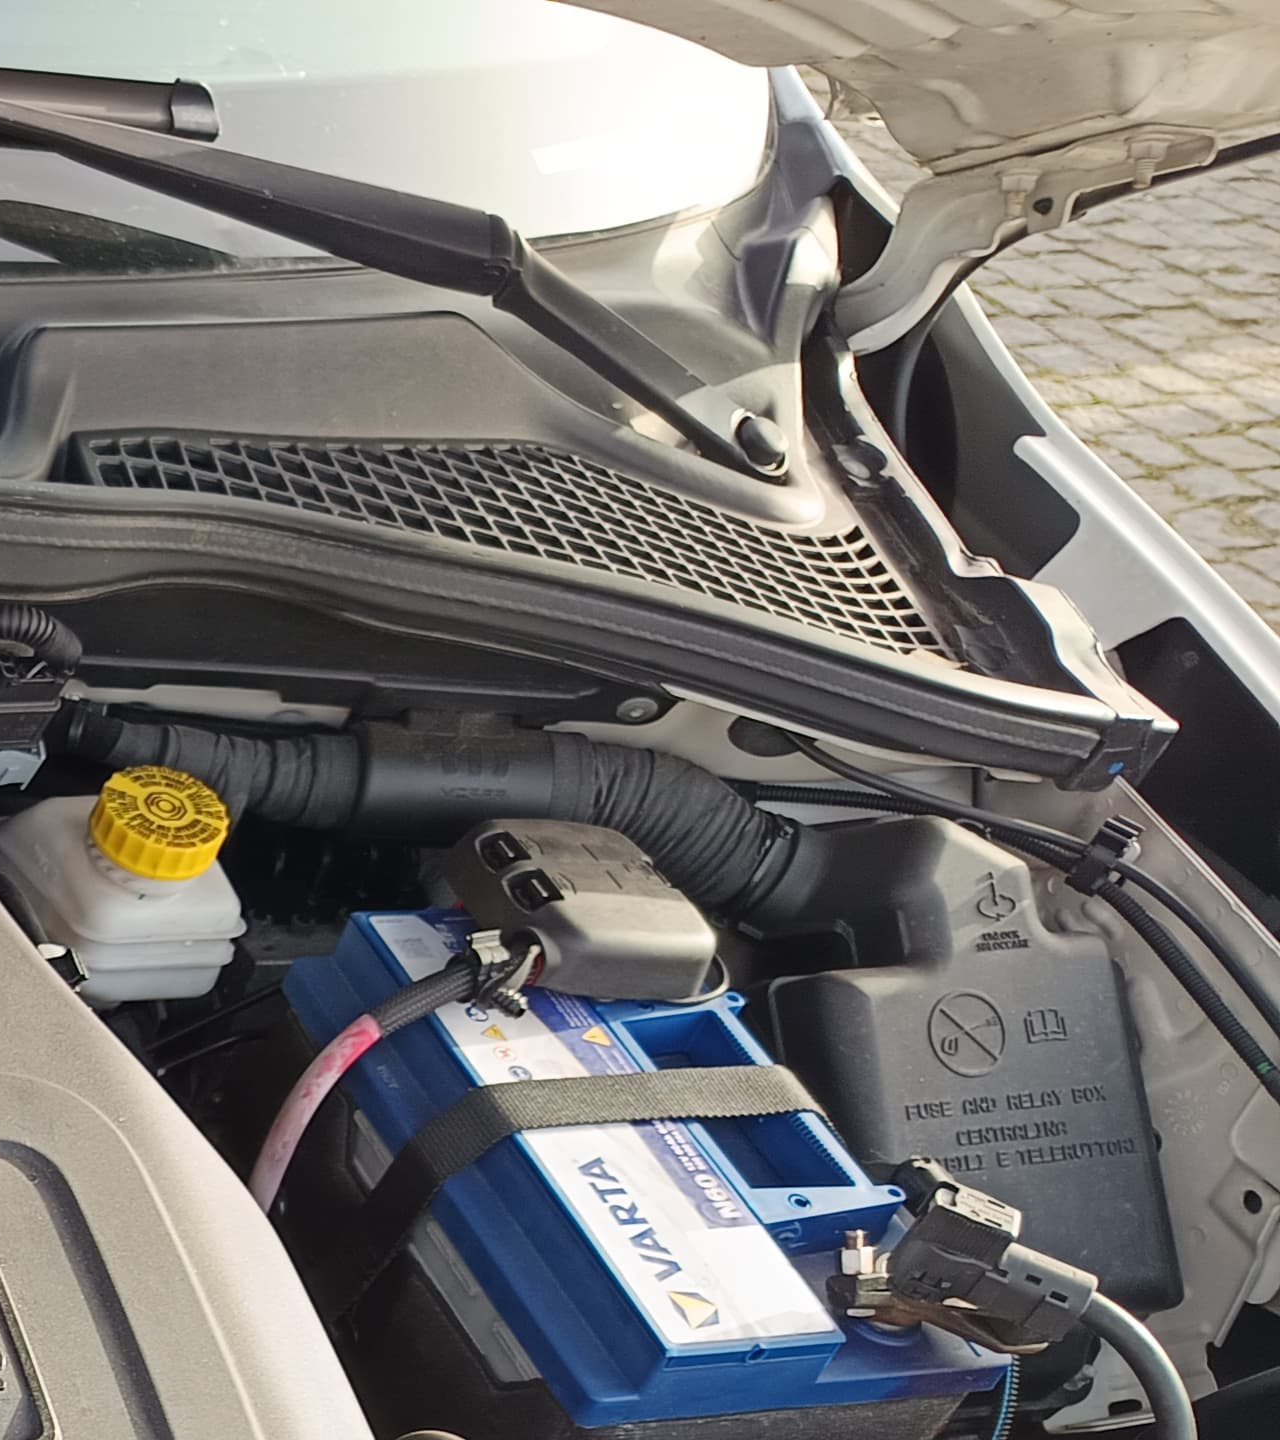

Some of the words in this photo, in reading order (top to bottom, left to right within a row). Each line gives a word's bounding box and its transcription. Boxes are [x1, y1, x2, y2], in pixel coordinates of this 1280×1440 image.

[904, 1101, 953, 1121] FUSE
[962, 1097, 996, 1115] AND
[1006, 1089, 1063, 1111] RELAY
[1071, 1084, 1107, 1104] BOX
[955, 1119, 1068, 1147] CENTRALINA
[996, 1151, 1011, 1169] E
[693, 1173, 743, 1219] N60
[577, 1156, 683, 1282] VARTA
